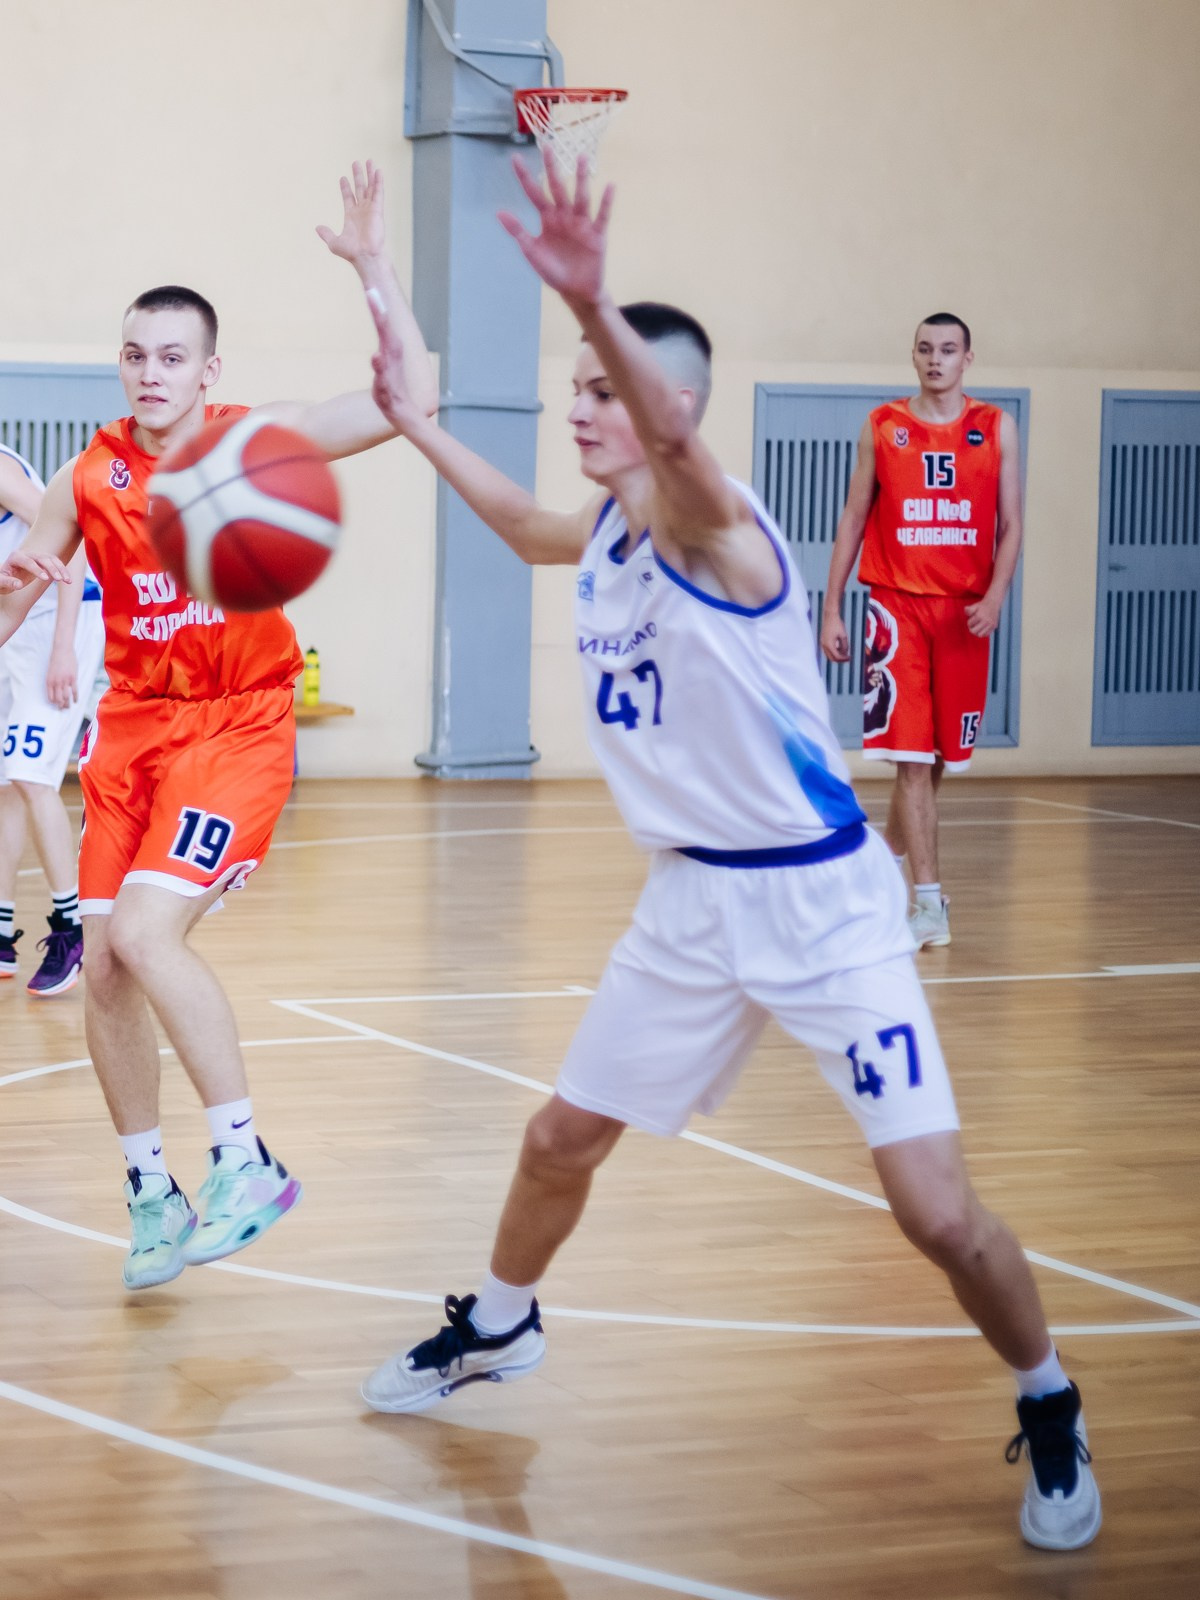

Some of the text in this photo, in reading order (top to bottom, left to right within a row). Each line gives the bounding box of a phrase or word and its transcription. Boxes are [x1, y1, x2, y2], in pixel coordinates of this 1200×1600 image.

[922, 452, 956, 490] 15
[903, 498, 934, 522] СШ
[896, 527, 978, 547] ЧЕЛЯБИНСК
[132, 571, 178, 606] СШ
[579, 621, 658, 657] ИНАМО
[596, 659, 663, 731] 47
[2, 723, 47, 758] 55
[960, 711, 981, 749] 15
[167, 806, 235, 874] 19
[846, 1023, 923, 1100] 47
